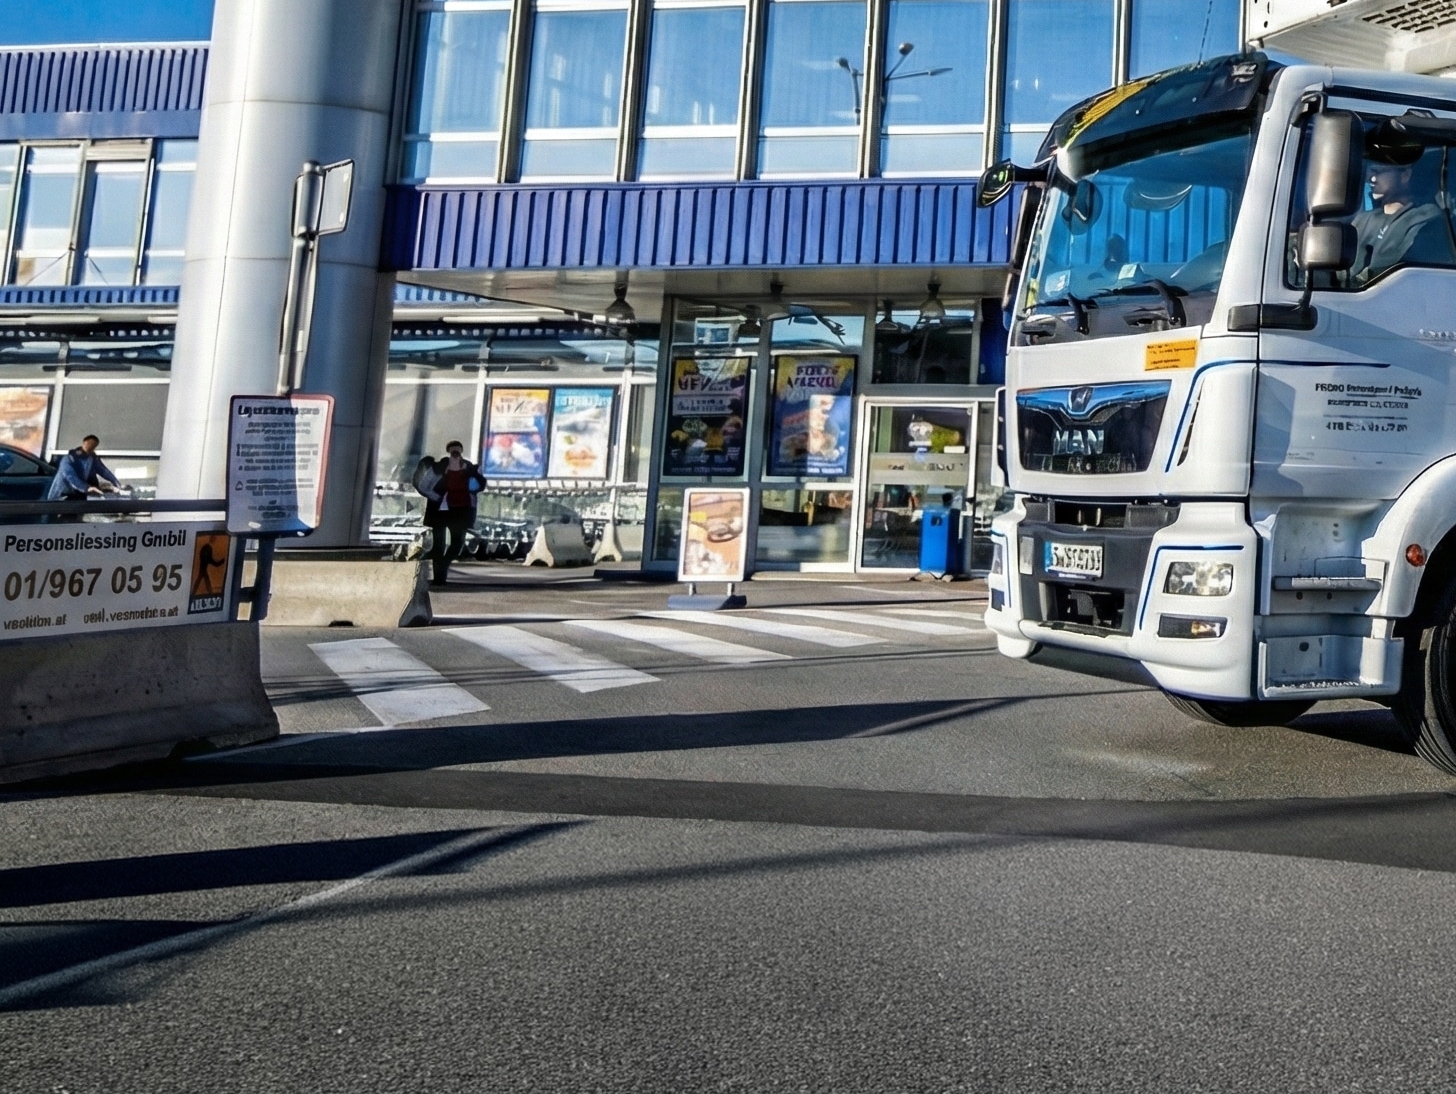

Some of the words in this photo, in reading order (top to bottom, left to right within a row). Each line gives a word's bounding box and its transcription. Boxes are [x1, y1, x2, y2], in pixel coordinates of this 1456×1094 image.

[4, 568, 102, 601] 01/967
[111, 565, 143, 594] 05
[152, 563, 183, 593] 95
